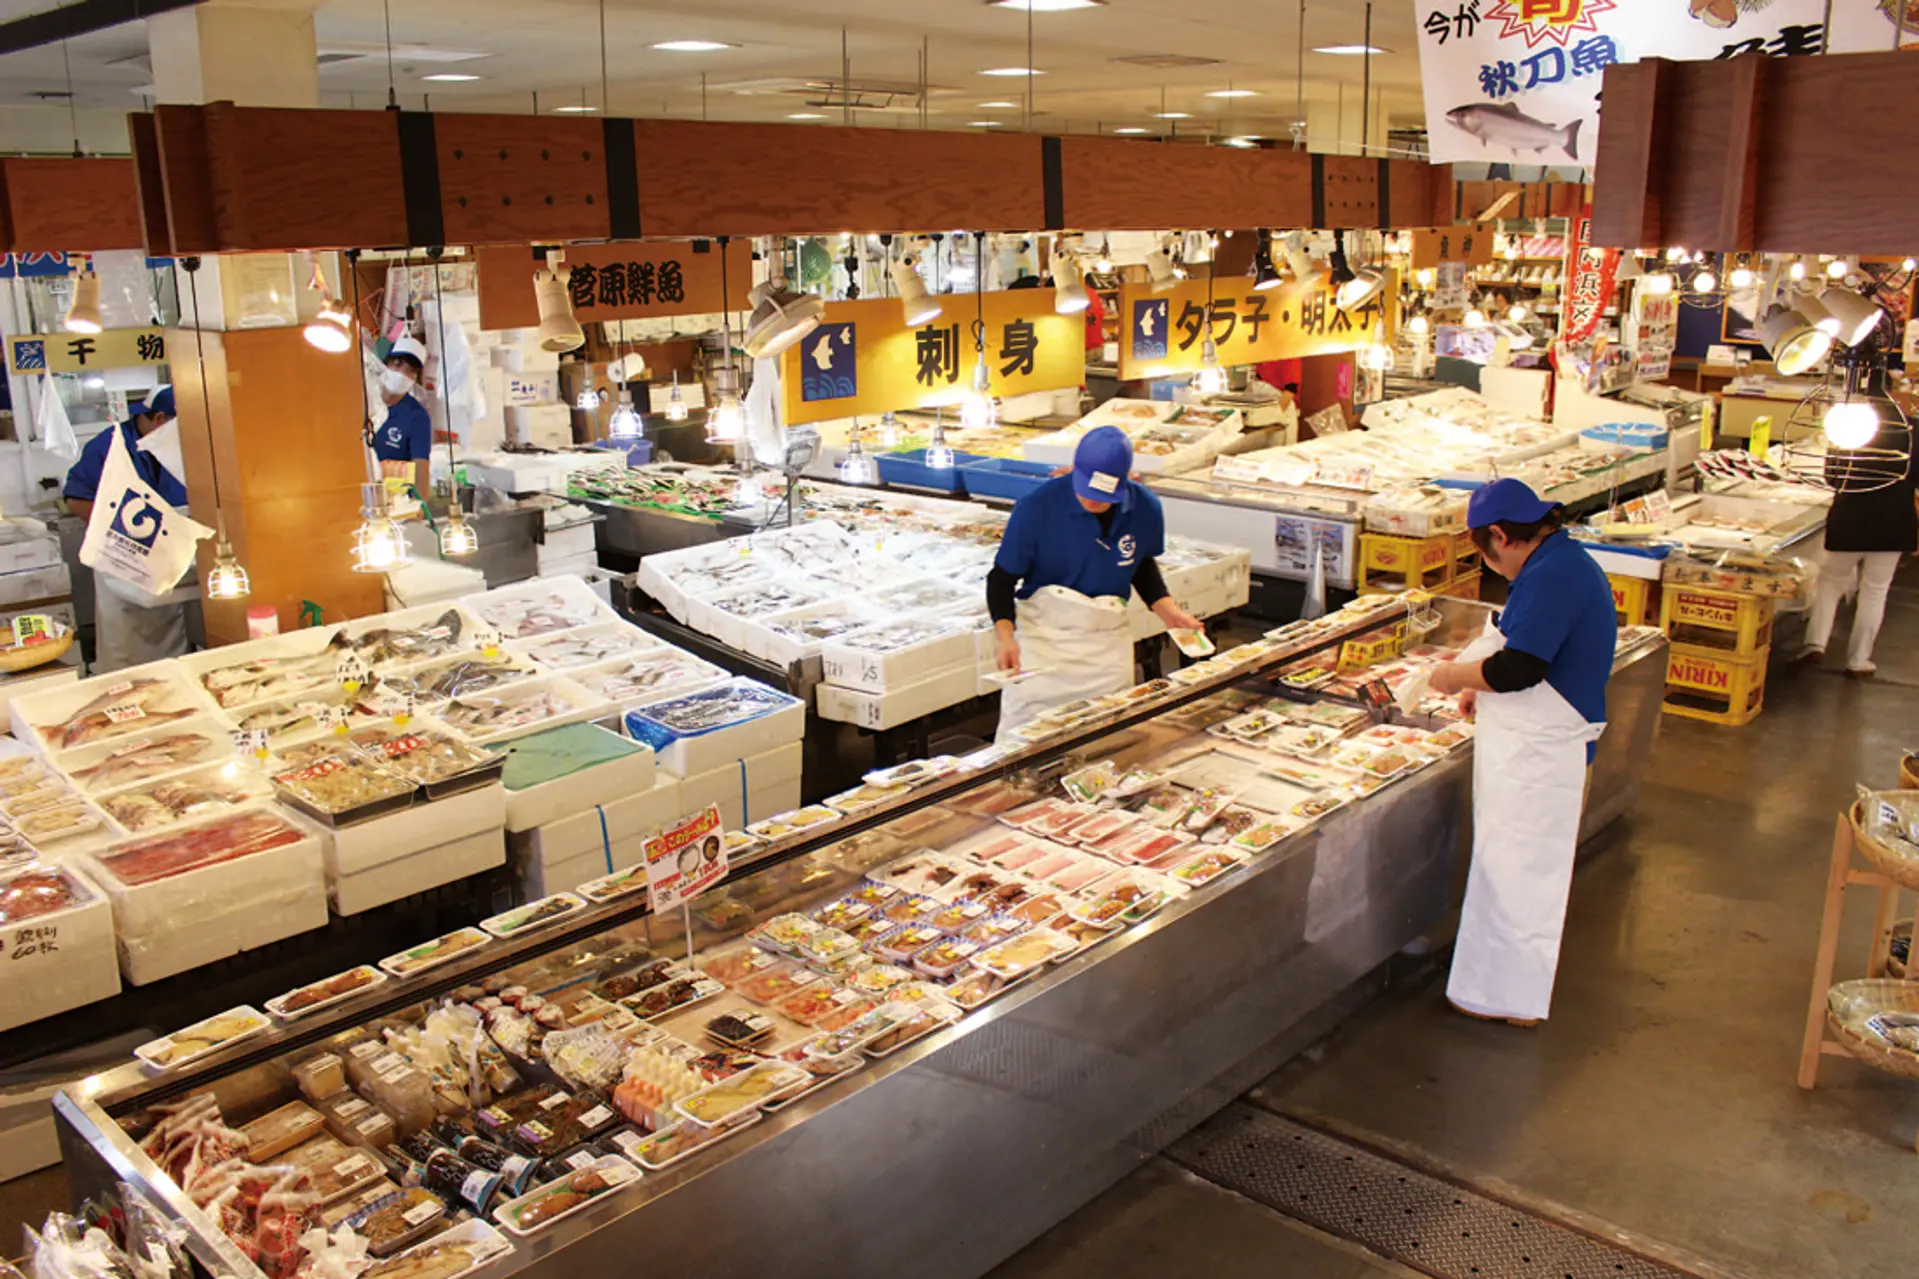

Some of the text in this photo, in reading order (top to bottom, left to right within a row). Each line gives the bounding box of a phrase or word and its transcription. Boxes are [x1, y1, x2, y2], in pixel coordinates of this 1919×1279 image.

[1424, 0, 1482, 45] 今が
[1478, 34, 1619, 98] 秋刀魚
[567, 260, 684, 308] 菅原鮮魚
[67, 334, 165, 365] 干物
[915, 318, 1039, 387] 刺身
[1669, 662, 1729, 689] KIRIN
